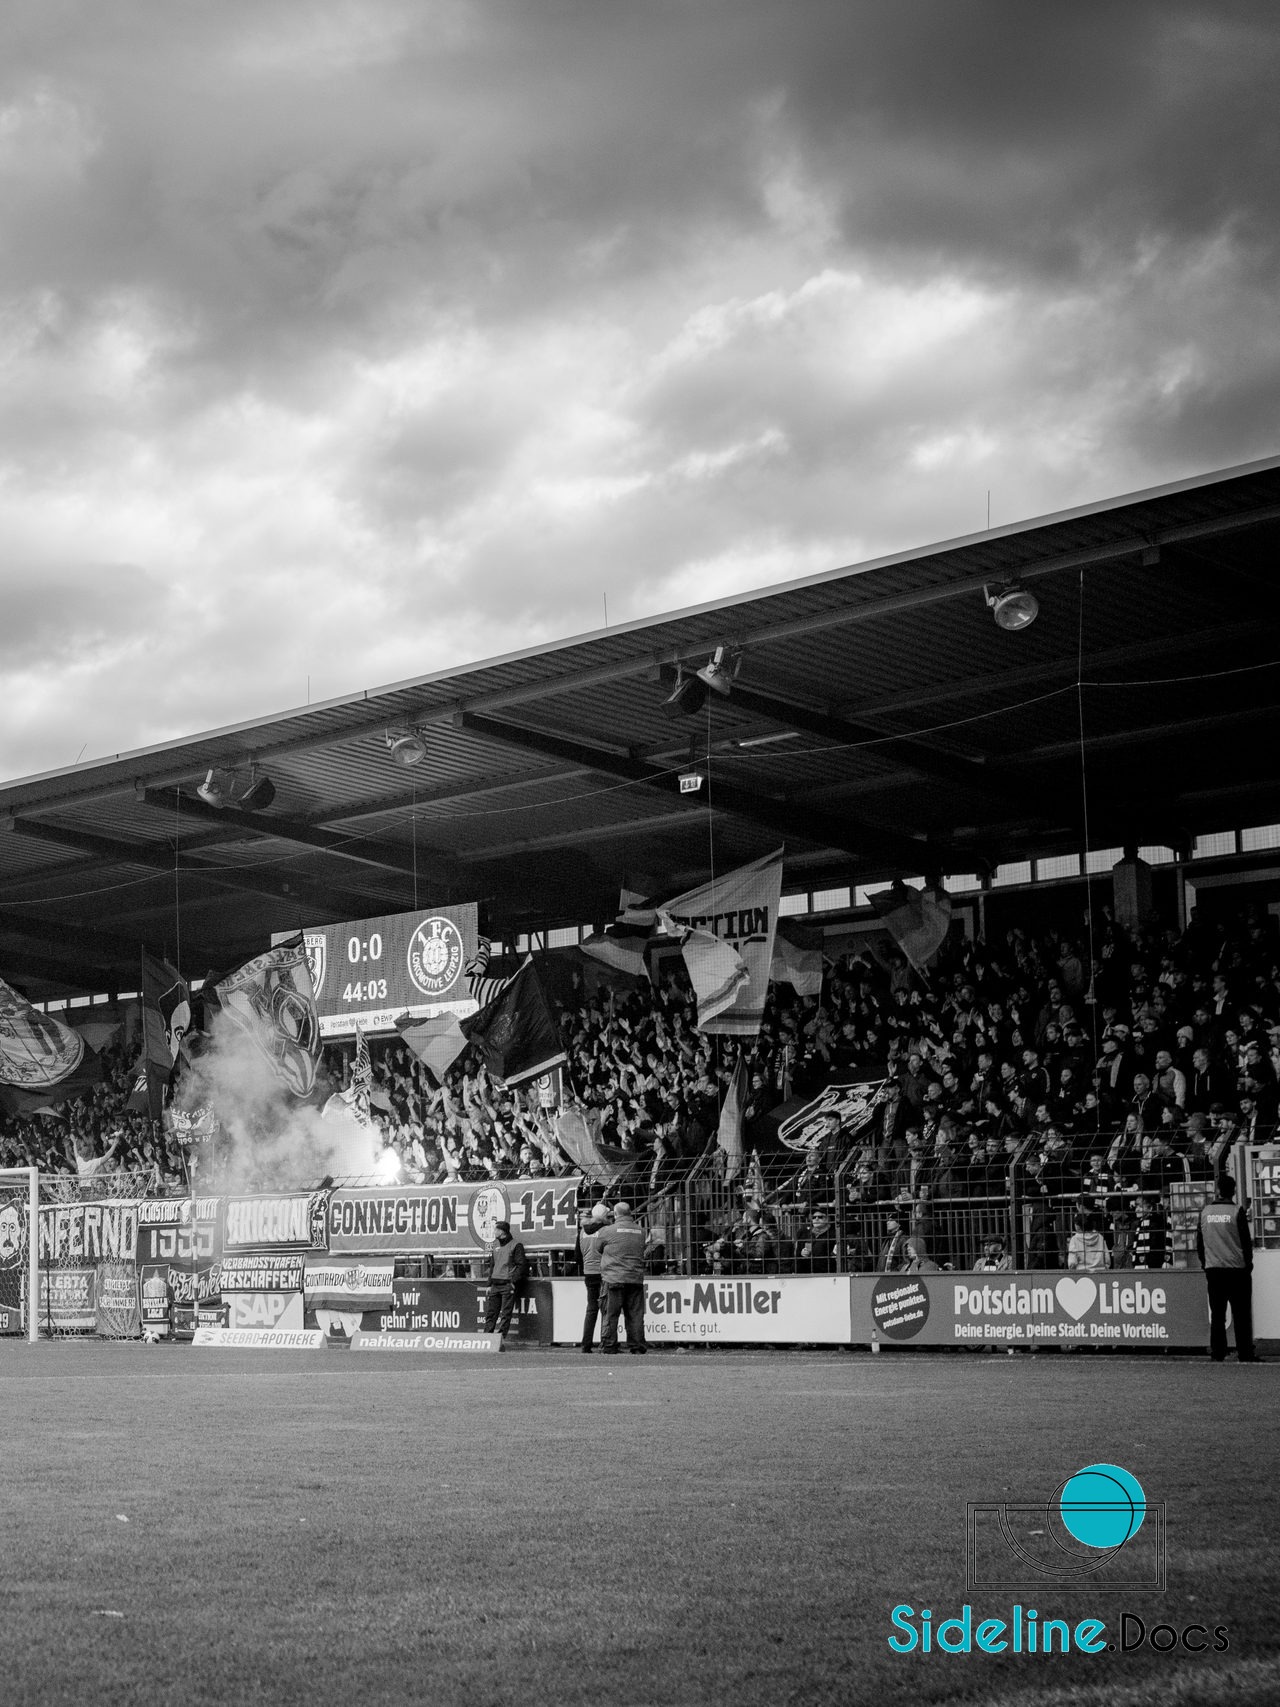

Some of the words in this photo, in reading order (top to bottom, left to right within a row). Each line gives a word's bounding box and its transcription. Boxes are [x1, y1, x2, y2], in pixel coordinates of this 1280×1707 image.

[348, 934, 382, 963] 0:0
[412, 951, 444, 989] LOKOMOTIVE
[443, 946, 459, 982] LEIPZIG
[342, 979, 388, 1002] 44:03
[330, 1196, 458, 1236] CONNECTION
[39, 1207, 138, 1260] NFERNO
[220, 1270, 301, 1289] ABSCHAFFEN!
[402, 1288, 420, 1305] wir
[477, 1297, 538, 1314] TLIA
[643, 1282, 781, 1315] fen-Müller
[954, 1283, 1054, 1315] Potsdam
[1099, 1281, 1167, 1314] Liebe
[235, 1293, 286, 1326] SAP
[411, 1311, 428, 1328] ins
[431, 1311, 460, 1328] KINO
[700, 1323, 720, 1336] gut.
[954, 1324, 983, 1338] Deine
[984, 1323, 1024, 1339] Energie.
[1026, 1323, 1057, 1338] Deine
[1058, 1323, 1089, 1337] Stadt.
[1090, 1323, 1120, 1338] Deine
[1122, 1323, 1169, 1338] Vorteile.
[359, 1336, 420, 1348] nahkauf
[423, 1337, 491, 1349] Oelmann
